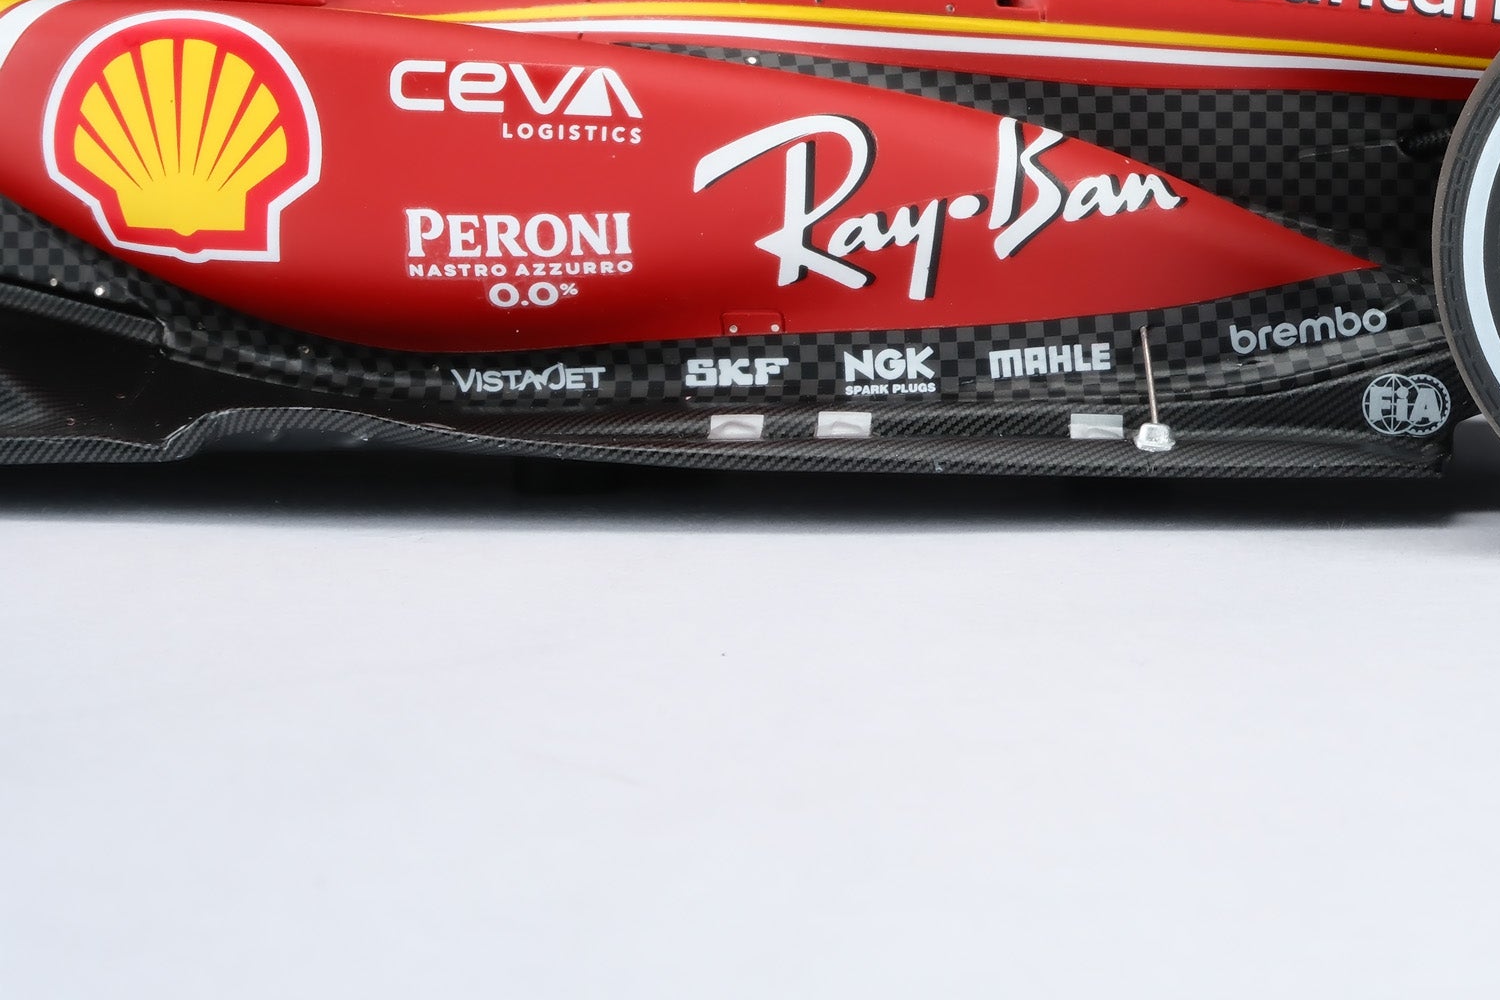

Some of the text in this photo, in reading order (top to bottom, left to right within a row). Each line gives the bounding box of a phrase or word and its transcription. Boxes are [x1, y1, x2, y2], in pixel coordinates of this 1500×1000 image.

[502, 122, 642, 144] LOGISTICS
[405, 208, 633, 257] PERONI
[408, 260, 634, 277] NASTRO AZZURRO
[488, 281, 579, 307] 0.0%
[1229, 306, 1387, 354] brembo
[685, 357, 790, 387] SKF
[843, 345, 936, 382] NGK
[989, 343, 1111, 379] MAHLE
[845, 382, 937, 396] SPARK PLUGS
